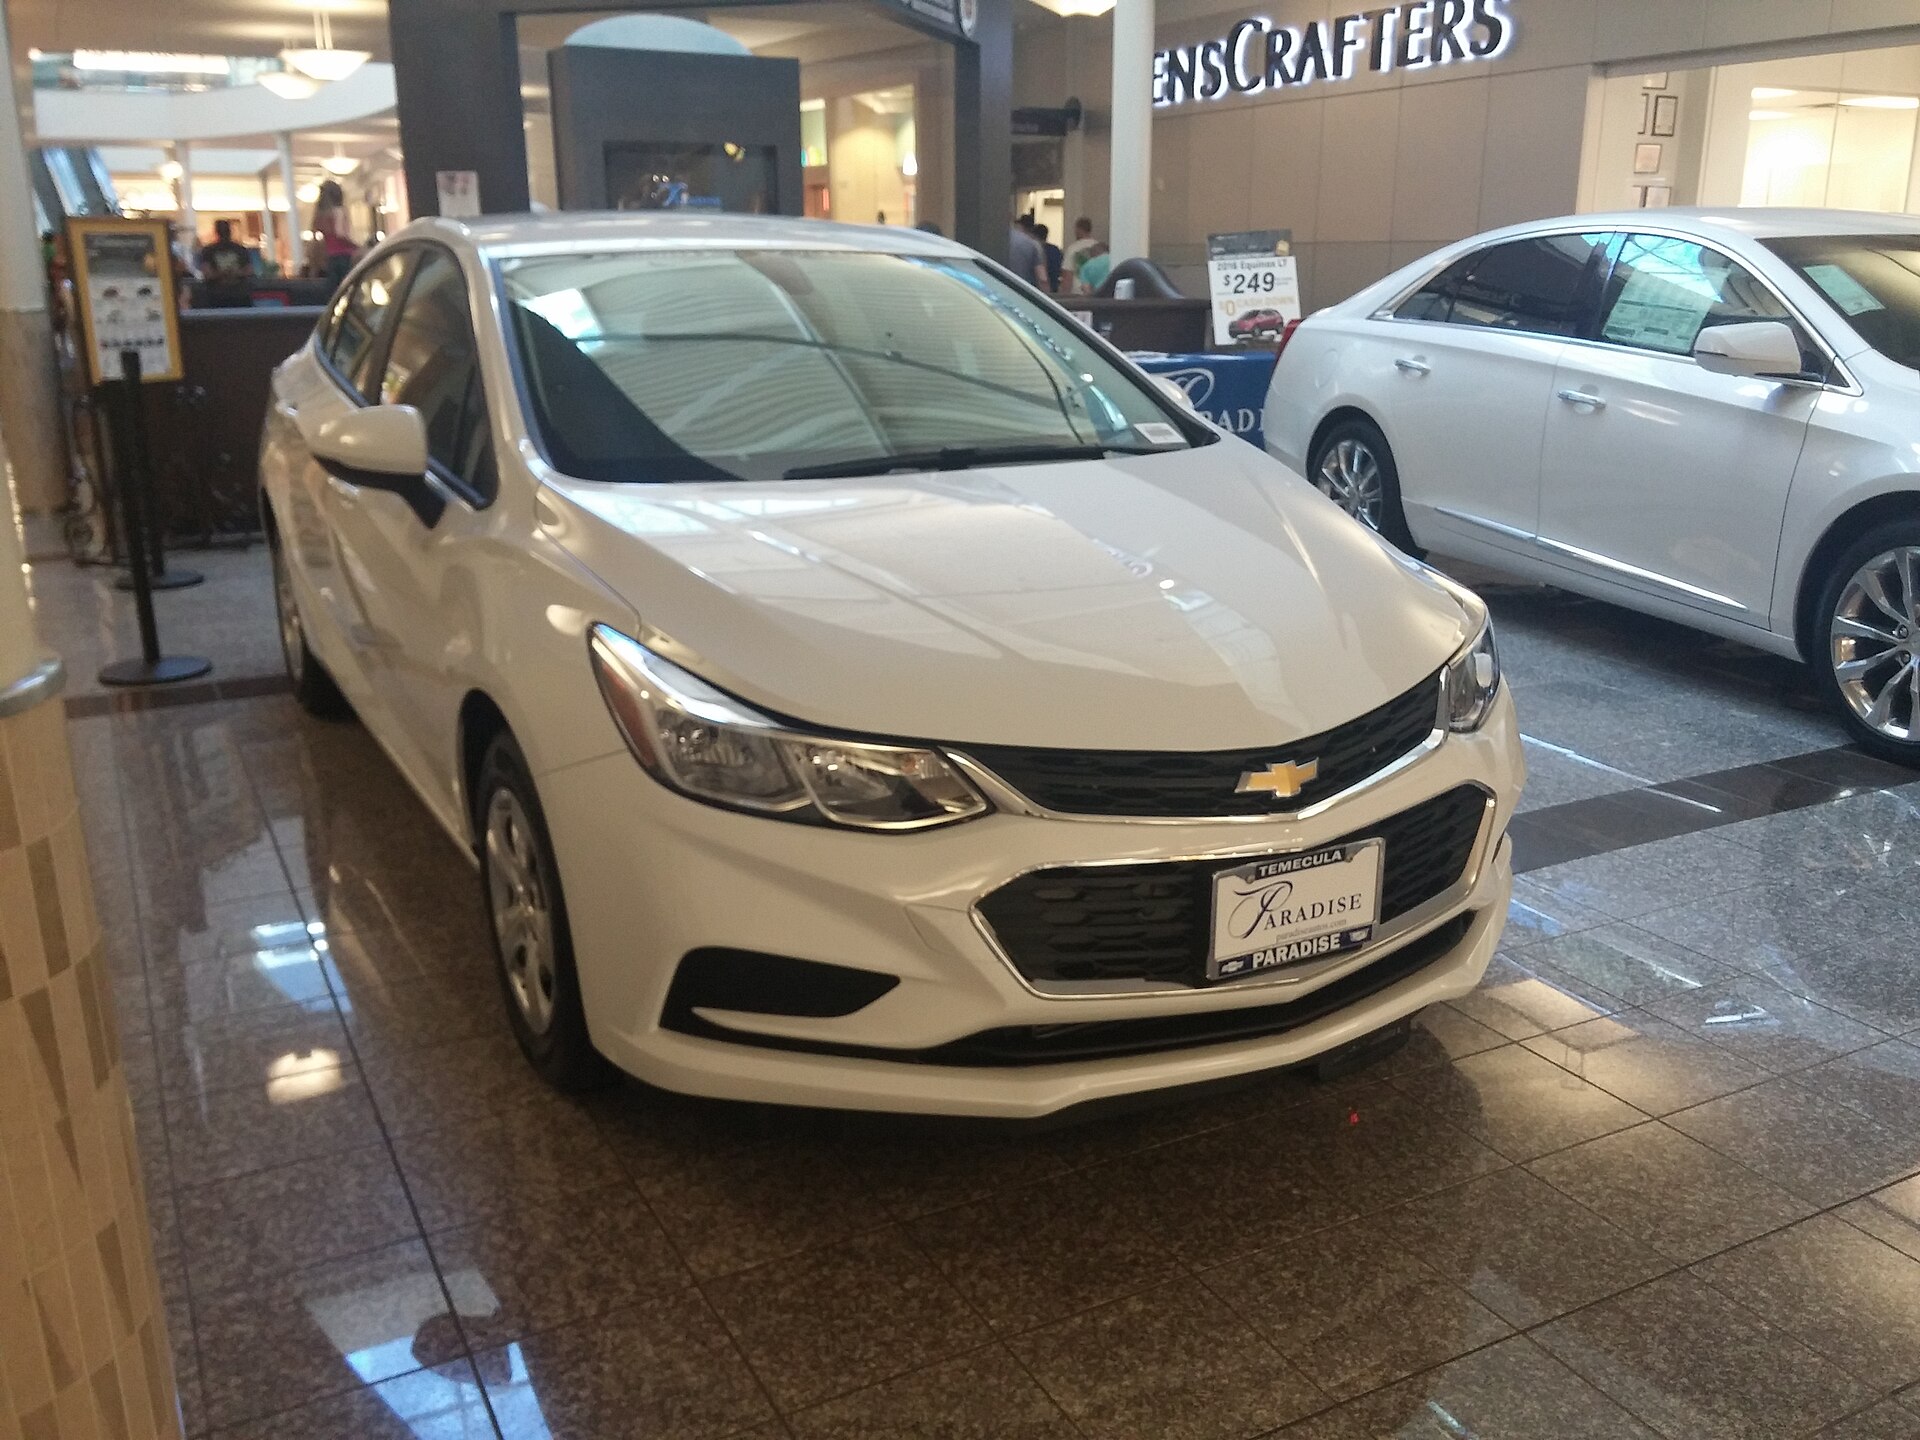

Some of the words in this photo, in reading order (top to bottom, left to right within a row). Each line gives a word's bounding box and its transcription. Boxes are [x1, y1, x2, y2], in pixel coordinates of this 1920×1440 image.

[1152, 0, 1503, 103] ENSCRAFTERS
[1258, 850, 1342, 877] TEMECULA
[1228, 880, 1362, 939] PARADISE
[1252, 932, 1341, 969] PARADISE
